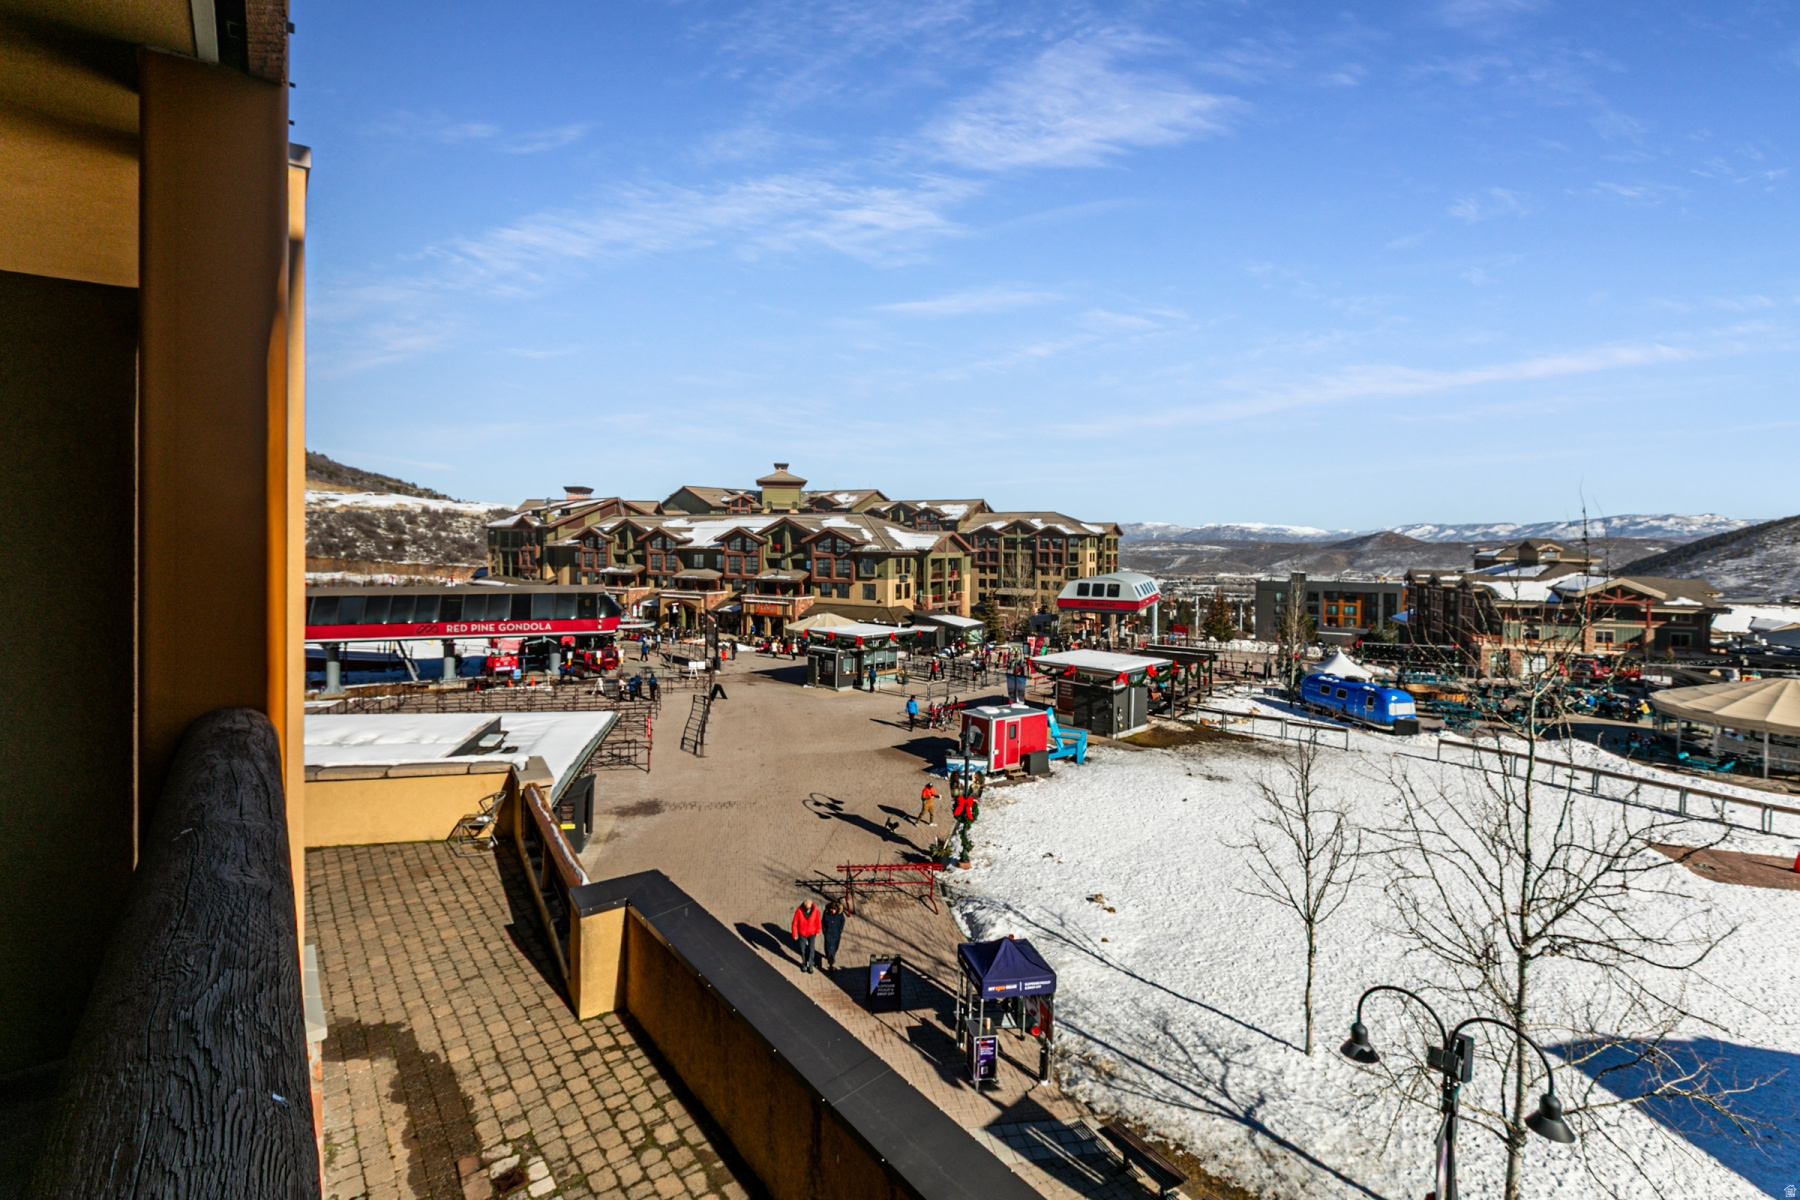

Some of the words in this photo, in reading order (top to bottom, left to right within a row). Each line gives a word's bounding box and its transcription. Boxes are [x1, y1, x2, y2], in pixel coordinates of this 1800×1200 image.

[446, 624, 468, 633] RED
[470, 624, 496, 632] PINE
[498, 622, 552, 632] GONDOLA
